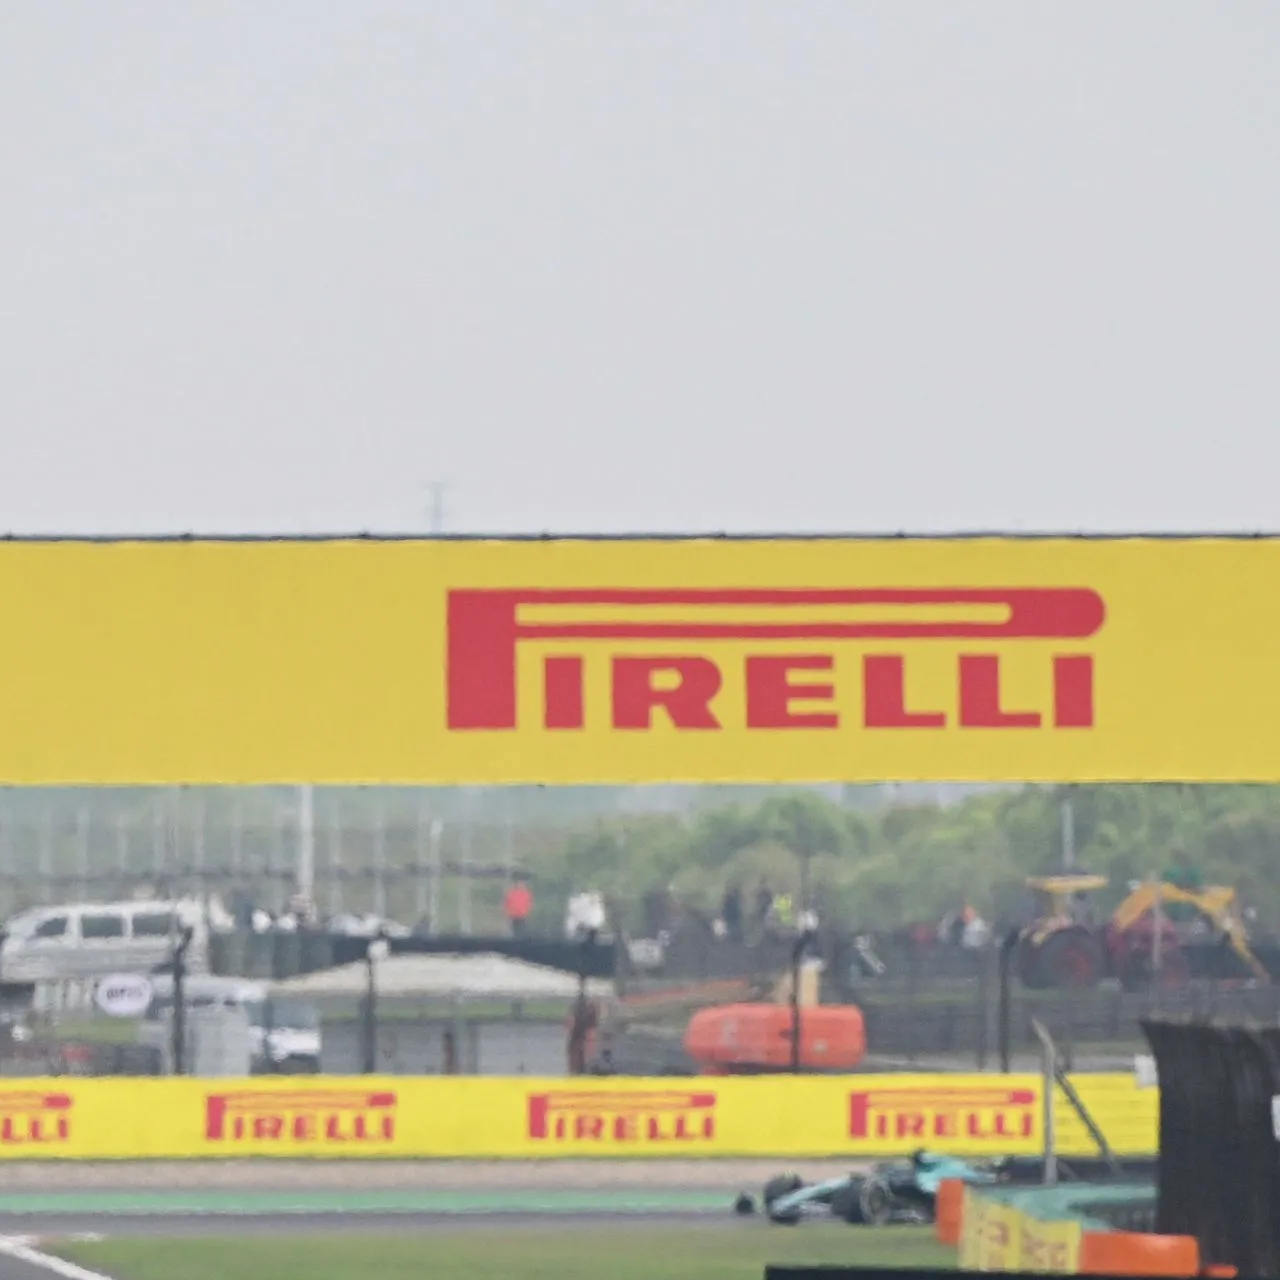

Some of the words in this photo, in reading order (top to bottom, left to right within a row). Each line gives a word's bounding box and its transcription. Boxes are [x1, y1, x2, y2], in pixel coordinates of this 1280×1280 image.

[444, 586, 1108, 733] PIRELLI
[204, 1091, 397, 1142] PIRELLI
[526, 1091, 718, 1142] PIRELLI
[848, 1087, 1037, 1140] PIRELLI
